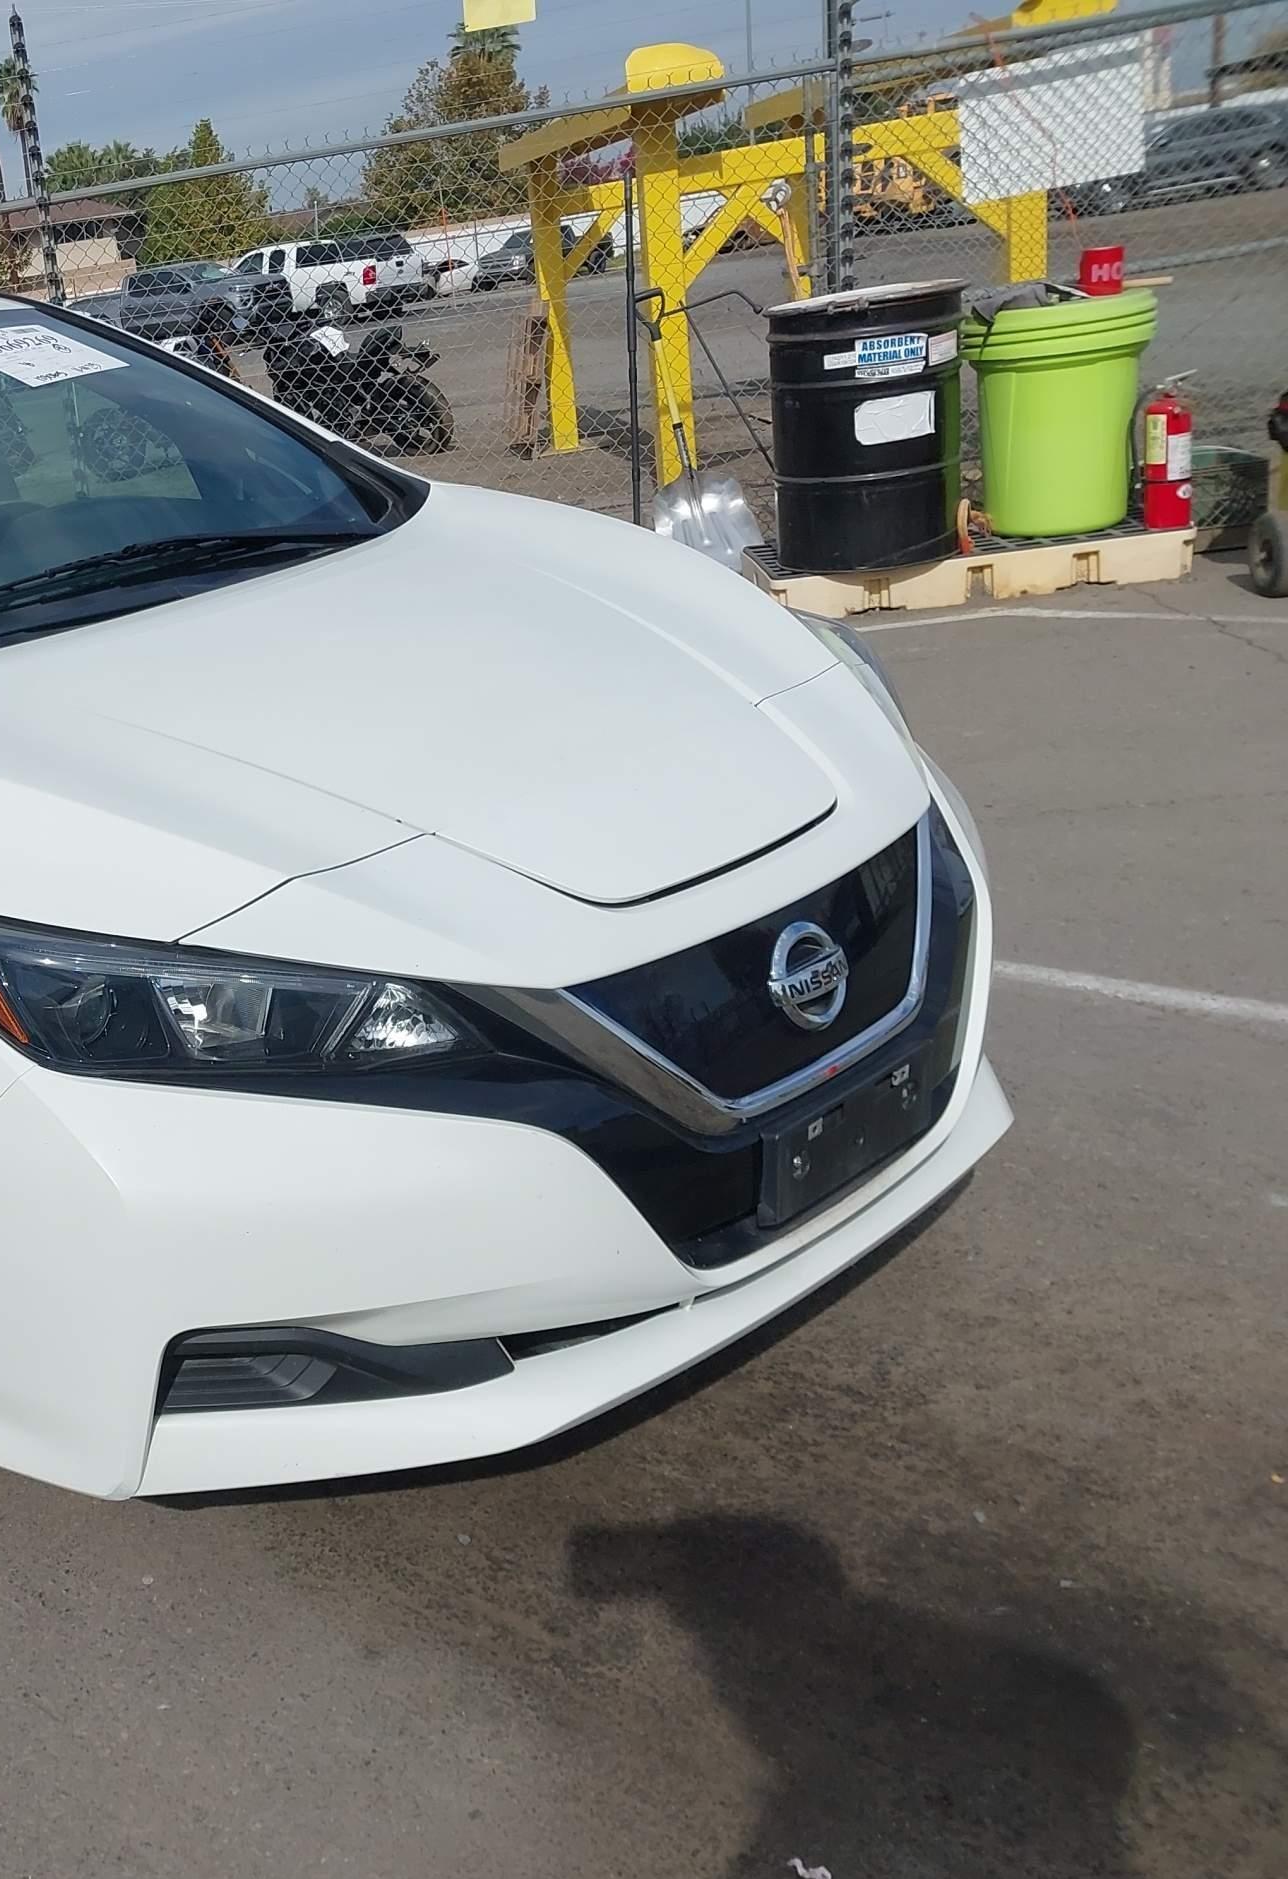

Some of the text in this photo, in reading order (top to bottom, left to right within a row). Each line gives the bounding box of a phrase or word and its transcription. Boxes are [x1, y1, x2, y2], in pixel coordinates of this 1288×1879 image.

[862, 336, 921, 351] ABSORBENT
[858, 349, 902, 364] MATERIAL
[904, 345, 924, 359] ONLY
[788, 959, 849, 999] NISSAN
